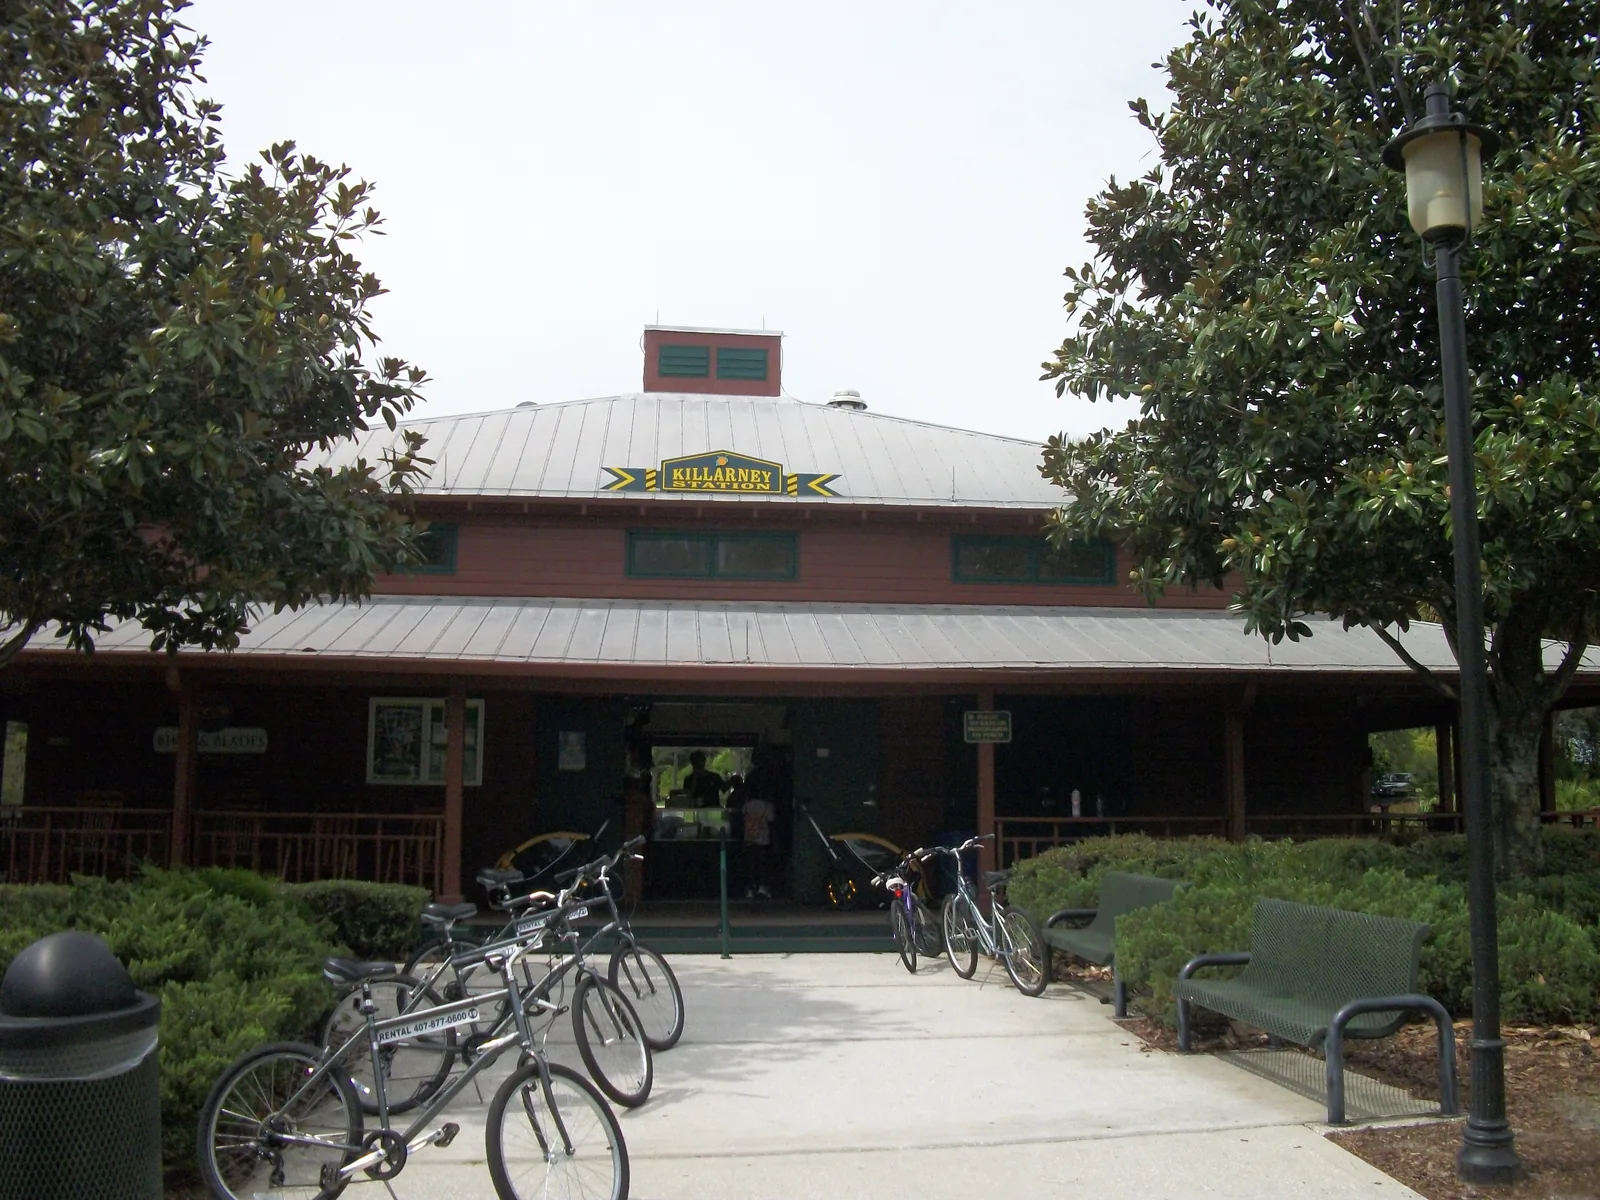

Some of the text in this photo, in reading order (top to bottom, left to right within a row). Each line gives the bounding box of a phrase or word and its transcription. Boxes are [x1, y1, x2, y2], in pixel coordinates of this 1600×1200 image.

[672, 467, 772, 483] KILLARNEY
[672, 481, 771, 490] STATION
[201, 734, 208, 747] &
[214, 734, 265, 747] BLADES
[379, 1027, 411, 1041] RENTAL
[414, 1012, 467, 1032] 407-877-0600
